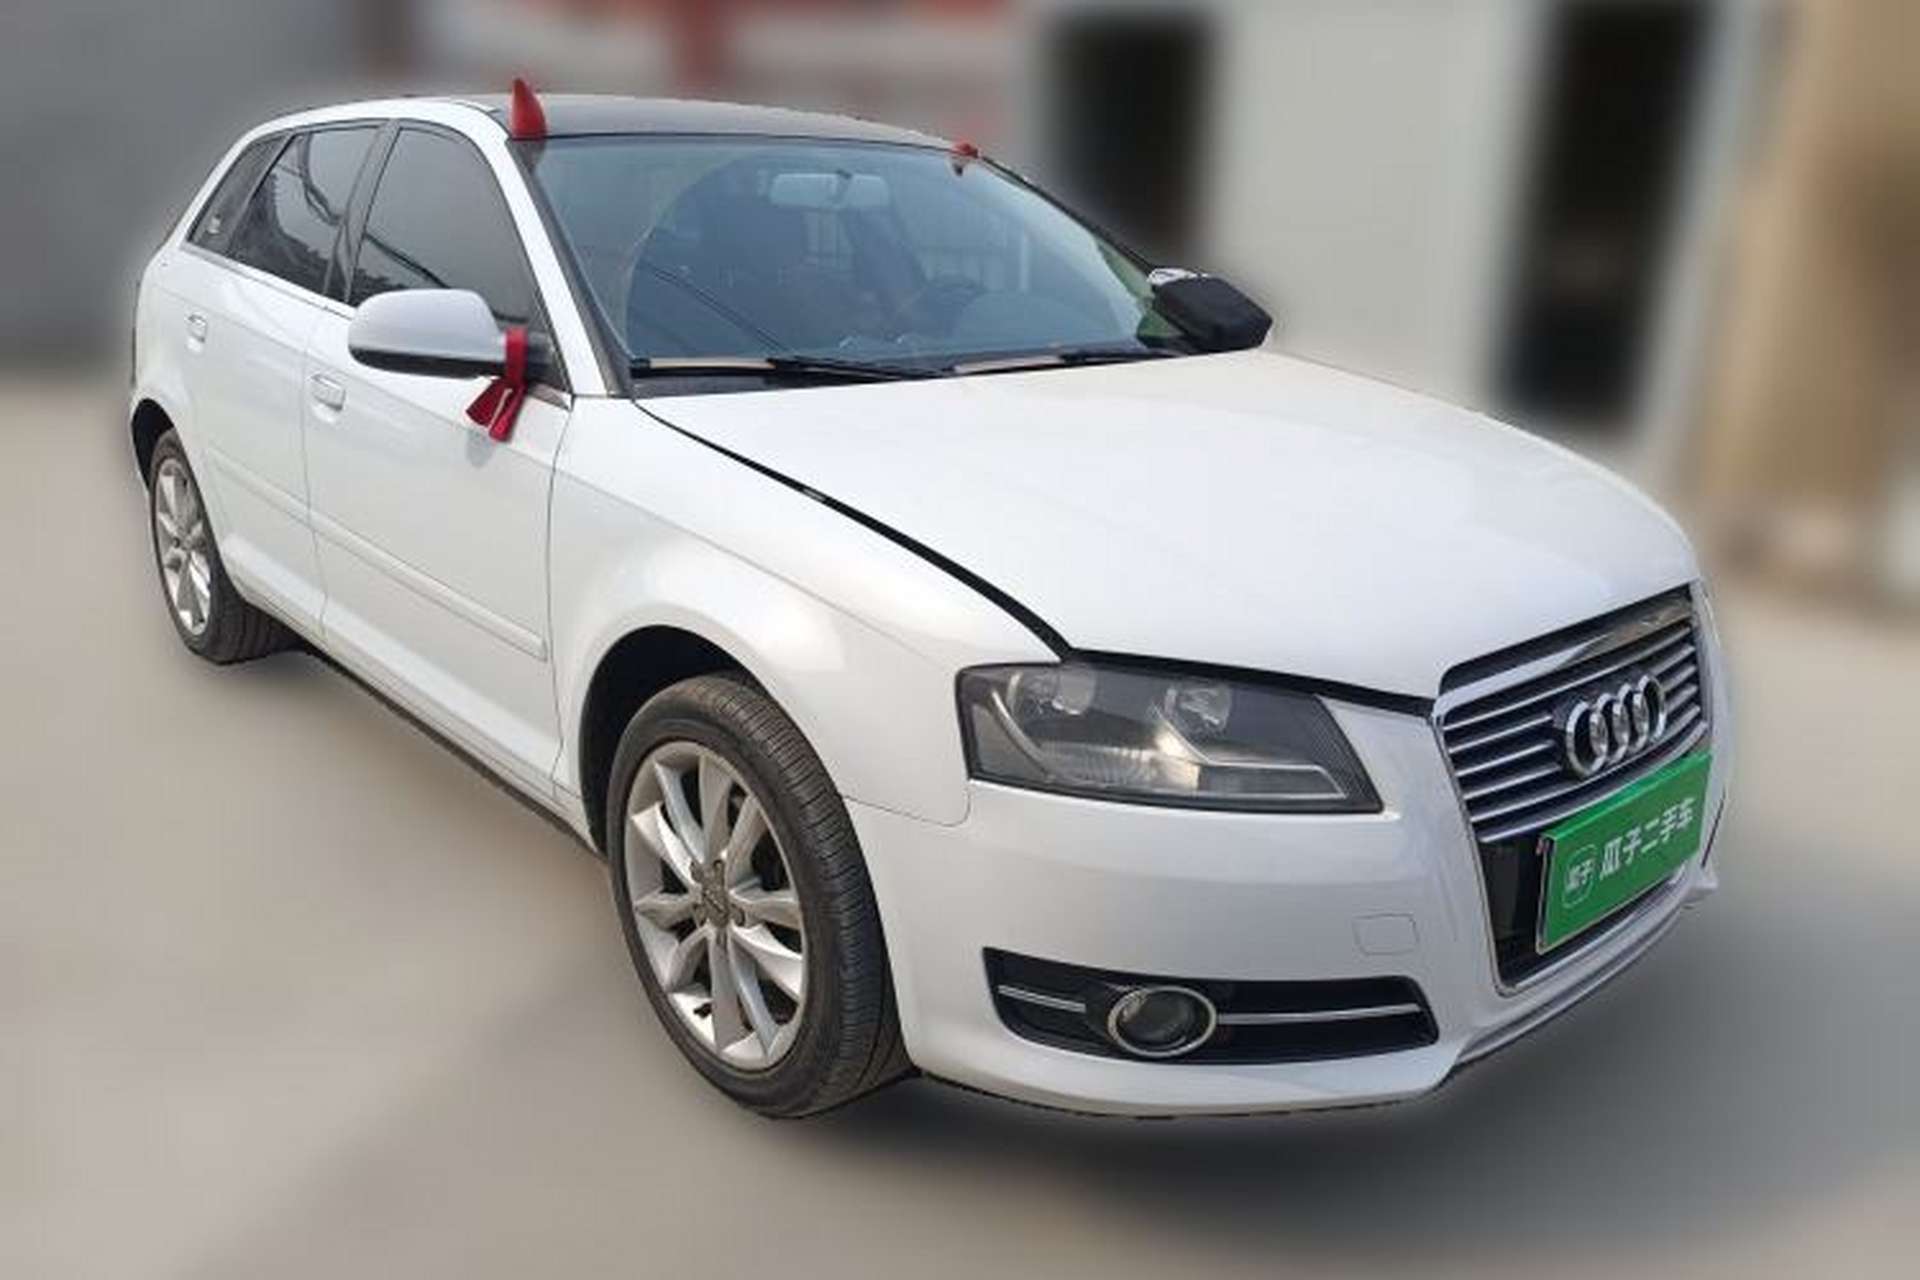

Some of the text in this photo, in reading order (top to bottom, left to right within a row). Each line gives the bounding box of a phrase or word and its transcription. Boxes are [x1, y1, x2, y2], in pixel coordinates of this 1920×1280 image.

[1600, 797, 1695, 879] 瓜子二手车
